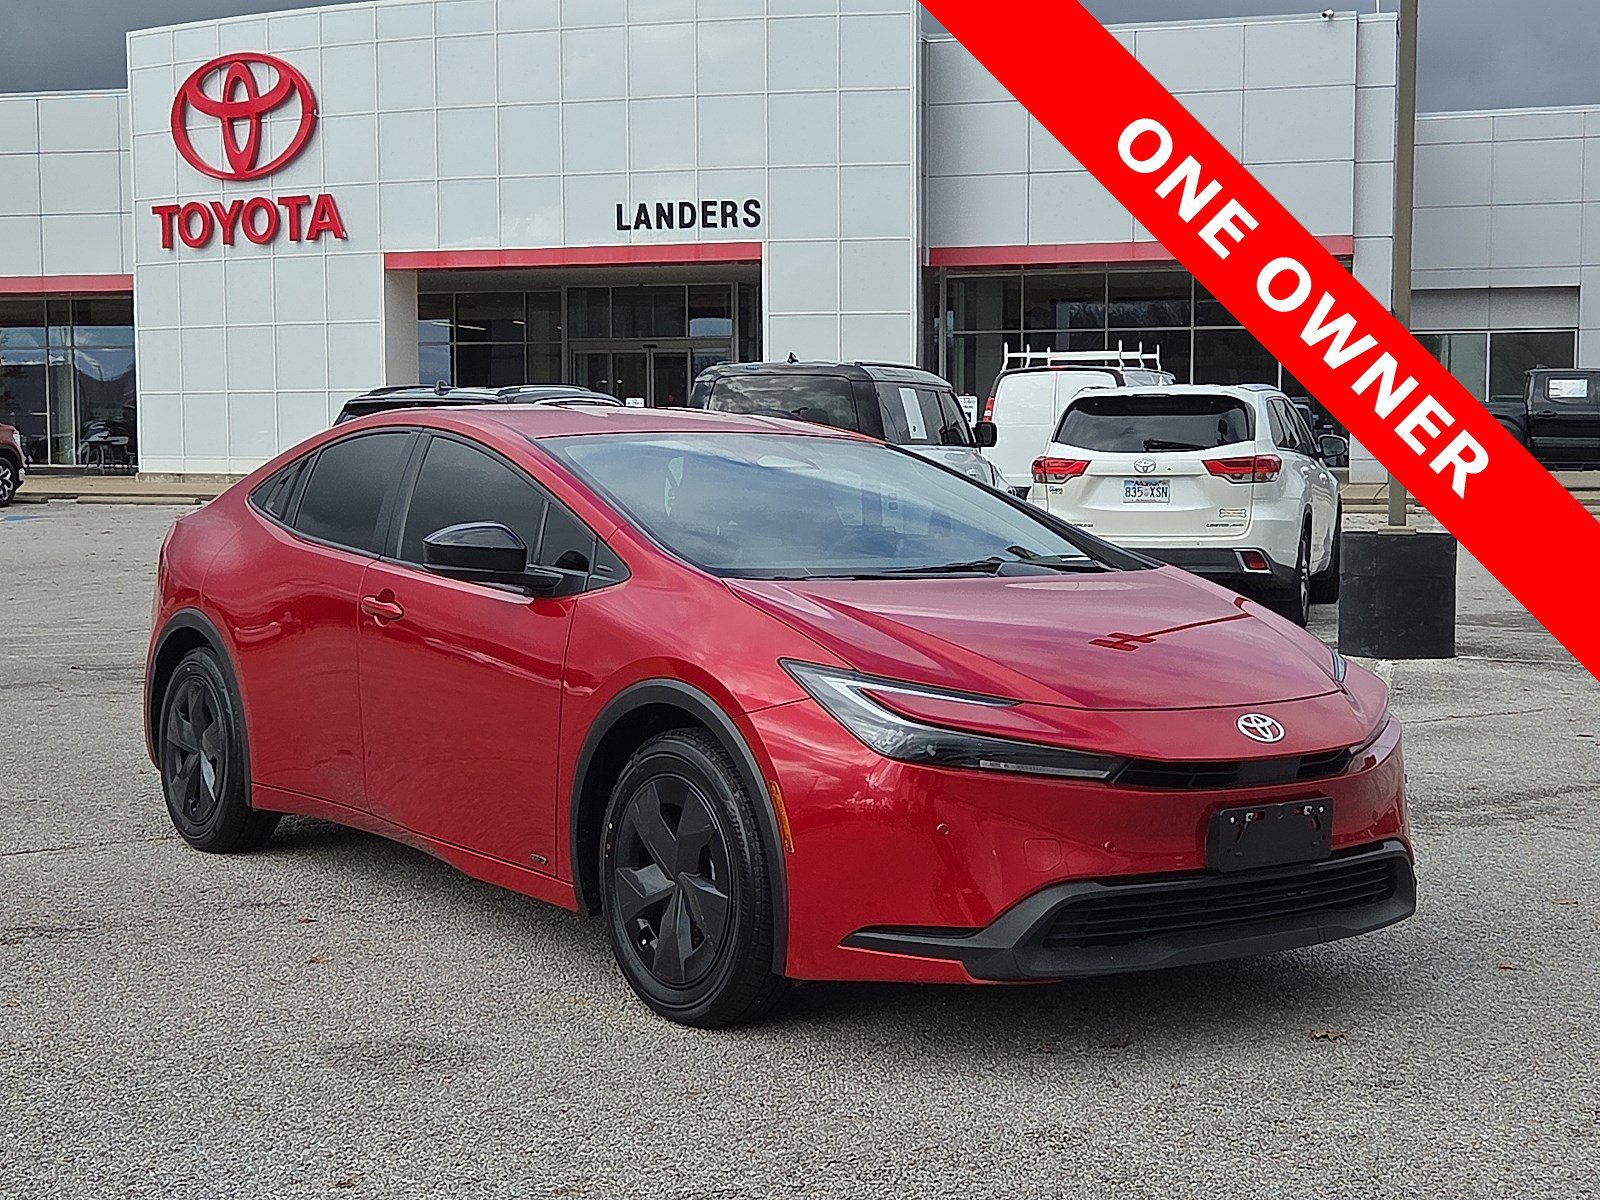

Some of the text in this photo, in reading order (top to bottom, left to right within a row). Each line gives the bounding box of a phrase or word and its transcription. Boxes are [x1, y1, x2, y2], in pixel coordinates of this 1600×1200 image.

[152, 194, 347, 248] TOYOTA
[616, 199, 761, 229] LANDERS
[1125, 487, 1168, 497] 835 XSN
